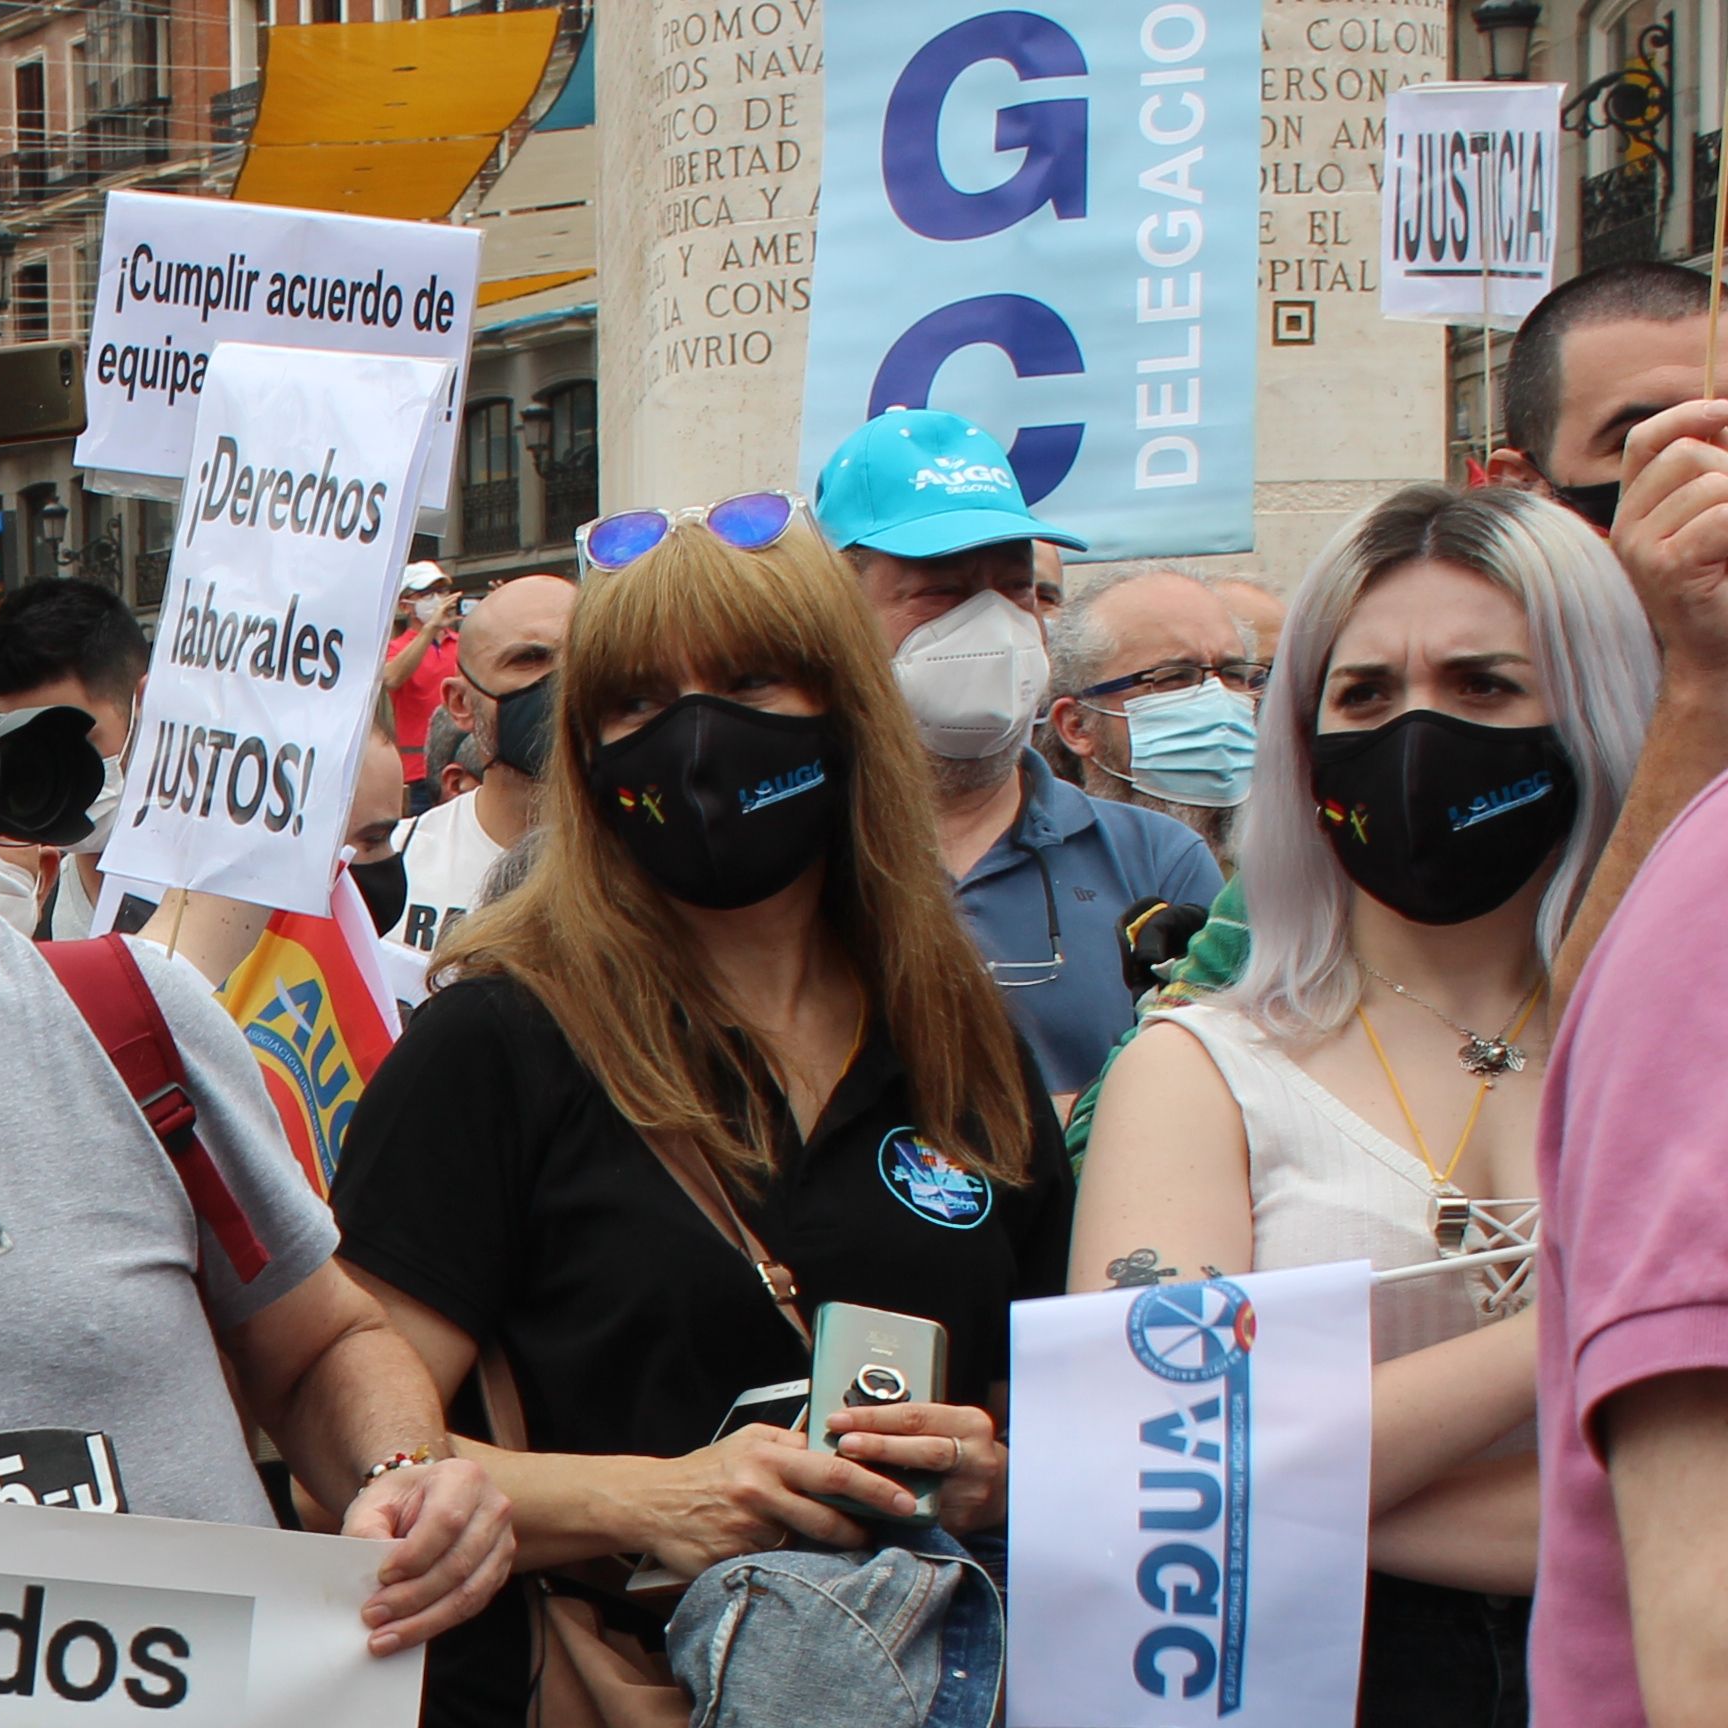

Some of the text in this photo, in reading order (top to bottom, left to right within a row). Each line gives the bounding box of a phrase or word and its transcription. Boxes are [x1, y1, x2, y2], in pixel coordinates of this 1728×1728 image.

[1306, 19, 1447, 59] COLONI
[745, 93, 797, 131] DE
[663, 141, 801, 193] LIBERTAD
[1308, 211, 1351, 245] EL
[114, 242, 456, 334] ¡Cumplir acuerdo de
[1258, 258, 1377, 292] PITAL
[187, 434, 389, 550] ¡Derechos
[169, 579, 344, 691] laborales
[132, 720, 316, 838] JUSTOS!
